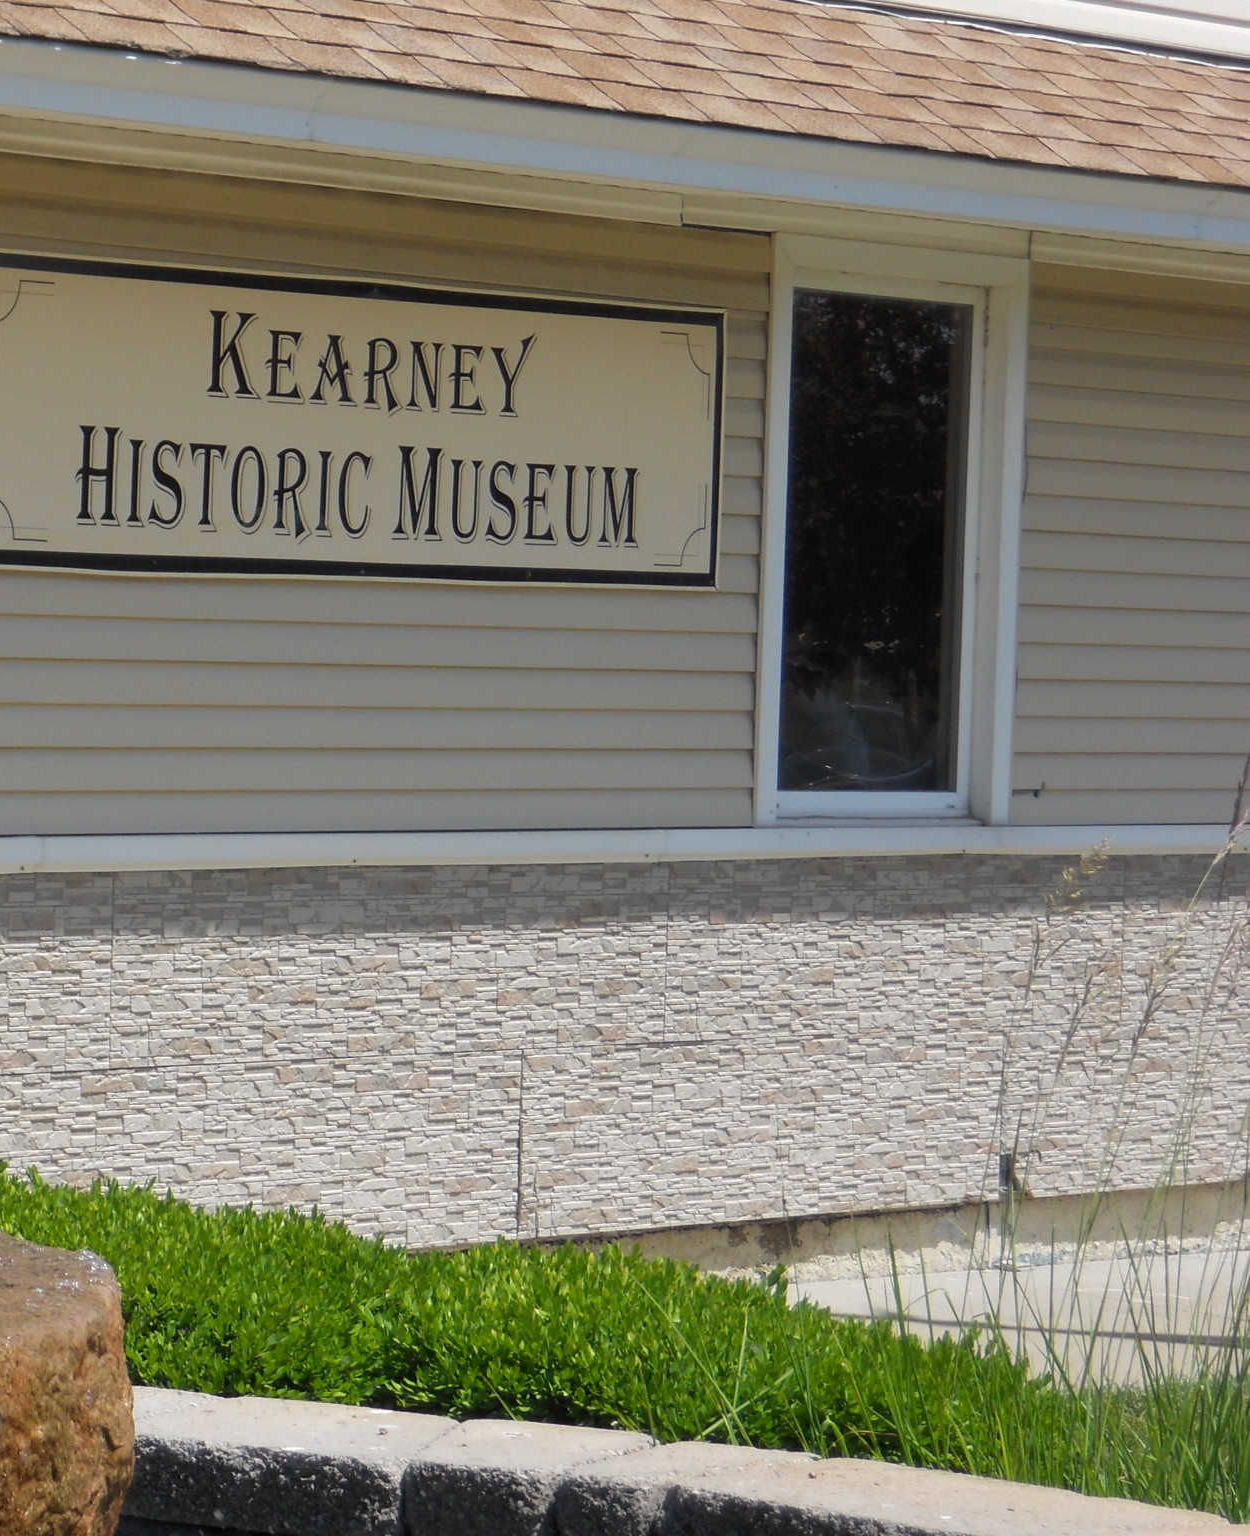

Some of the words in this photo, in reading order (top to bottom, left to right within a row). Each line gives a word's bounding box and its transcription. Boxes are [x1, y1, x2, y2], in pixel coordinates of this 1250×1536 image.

[207, 309, 537, 418] KEARNEY
[75, 424, 373, 545] HISTORIC
[391, 445, 641, 549] MUSEUM
